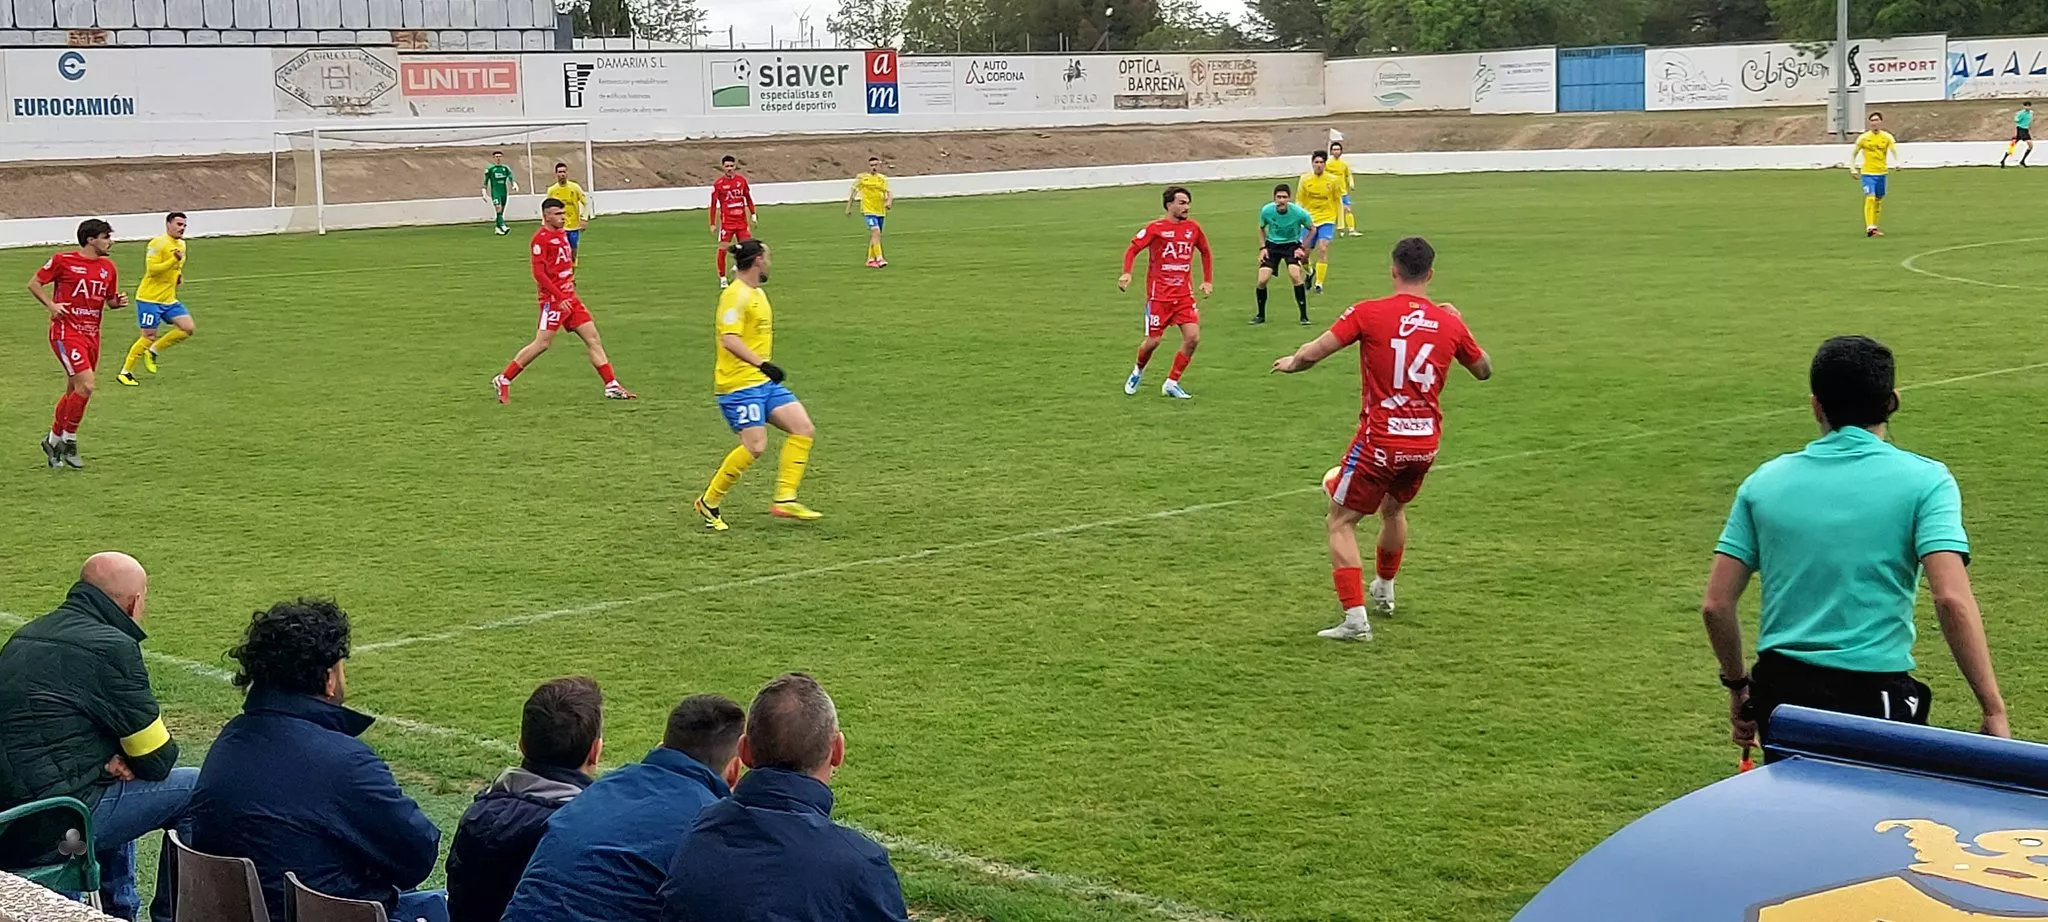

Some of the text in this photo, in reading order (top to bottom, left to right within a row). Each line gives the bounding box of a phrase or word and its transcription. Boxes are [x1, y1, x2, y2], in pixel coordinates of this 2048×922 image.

[597, 57, 648, 69] DAMARIM
[759, 57, 850, 87] siaver
[873, 53, 891, 75] a
[983, 61, 1008, 70] AUTO
[1868, 60, 1937, 73] SOMPORT
[1950, 50, 2048, 78] AZAL
[408, 68, 510, 90] UNITIC
[986, 71, 1025, 82] CORONA
[1128, 73, 1186, 92] BARREÑA
[760, 89, 833, 101] especialistas en
[868, 87, 897, 108] m
[13, 94, 134, 116] EUROCAMIÓN
[760, 100, 837, 112] césped deportivo
[1162, 241, 1193, 260] ATH
[71, 278, 108, 300] ATH
[142, 312, 154, 326] 10
[547, 311, 561, 321] 21
[1150, 314, 1161, 327] 18
[70, 347, 81, 361] 6
[1390, 338, 1436, 393] 14
[736, 403, 761, 424] 20
